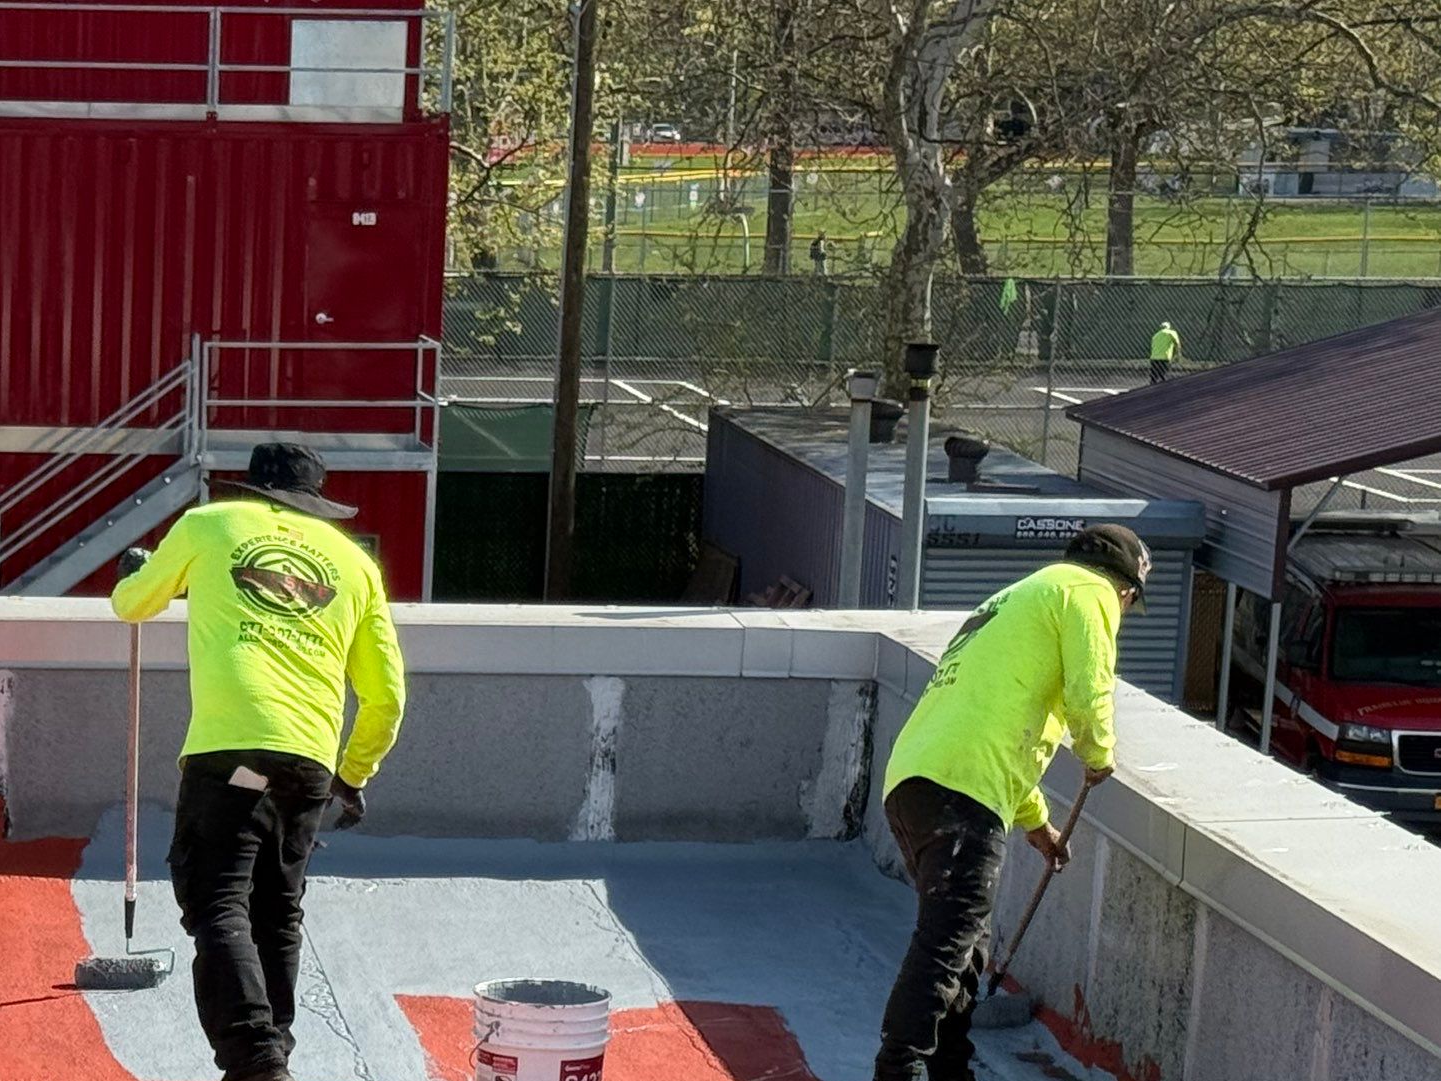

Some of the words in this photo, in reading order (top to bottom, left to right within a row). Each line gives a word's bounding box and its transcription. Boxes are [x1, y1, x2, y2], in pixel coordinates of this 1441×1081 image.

[1017, 517, 1084, 531] CASSONE
[230, 534, 297, 561] EXPERIENCE
[299, 543, 341, 582] MATTERS
